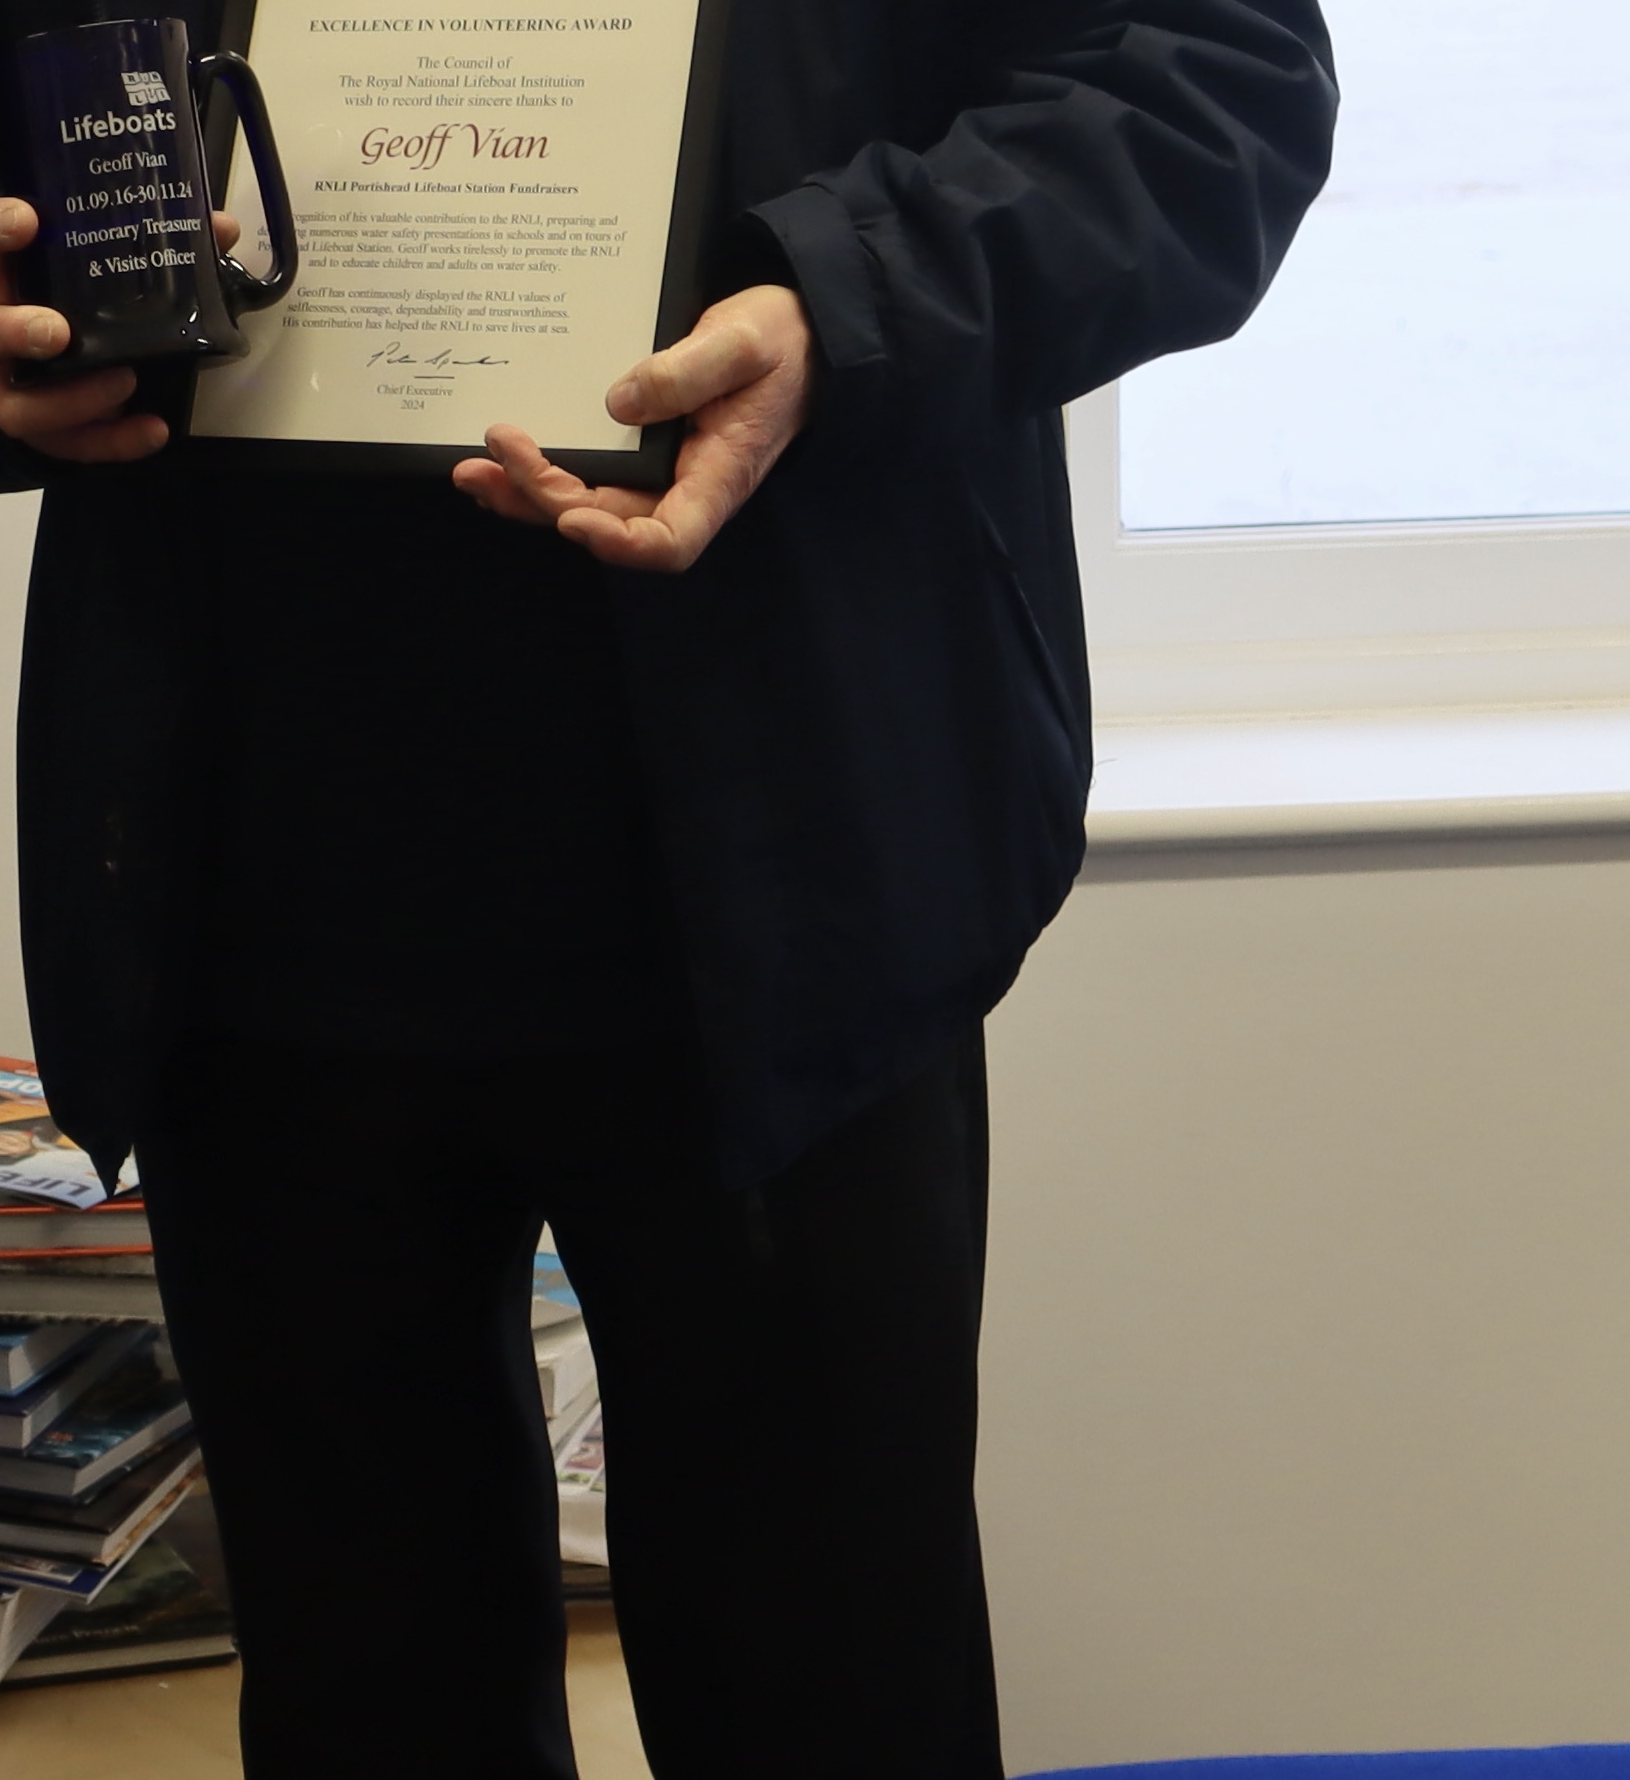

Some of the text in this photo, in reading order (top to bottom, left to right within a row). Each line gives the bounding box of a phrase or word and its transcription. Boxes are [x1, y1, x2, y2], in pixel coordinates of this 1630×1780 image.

[309, 17, 632, 31] EXCELLENCE IN VOLUNTEERING AWARD
[416, 55, 513, 69] The Council of
[338, 74, 585, 91] The Royal National Lifeboat Institution
[344, 93, 573, 106] wish to record their sincere thanks to
[60, 108, 177, 144] Lifeboats
[361, 123, 551, 170] Geoff Vian
[89, 150, 168, 175] Geoff Vian
[314, 180, 578, 194] RNLI Portishead Lifeboat Station Fundraisers
[338, 210, 352, 222] of
[351, 211, 367, 222] his
[369, 211, 412, 223] valuable
[414, 212, 476, 224] contribution
[478, 214, 489, 224] to
[491, 213, 508, 224] the
[510, 213, 543, 226] RNLI,
[545, 216, 596, 228] preparing
[598, 214, 618, 226] and
[65, 218, 202, 248] Honorary Treasurer
[311, 240, 620, 258] Lifeboat Station. Geoff works tirelessly to promote the RNLI
[89, 249, 197, 278] & Visits Officer
[307, 255, 561, 274] and to educate children and adults on water safety.
[297, 286, 566, 302] Geoff has continuously displayed the RNLI values of
[287, 300, 347, 314] selflessness,
[349, 305, 393, 317] courage,
[395, 303, 464, 318] dependability
[466, 304, 486, 316] and
[376, 383, 453, 396] Chief Executive
[399, 398, 425, 410] 2024
